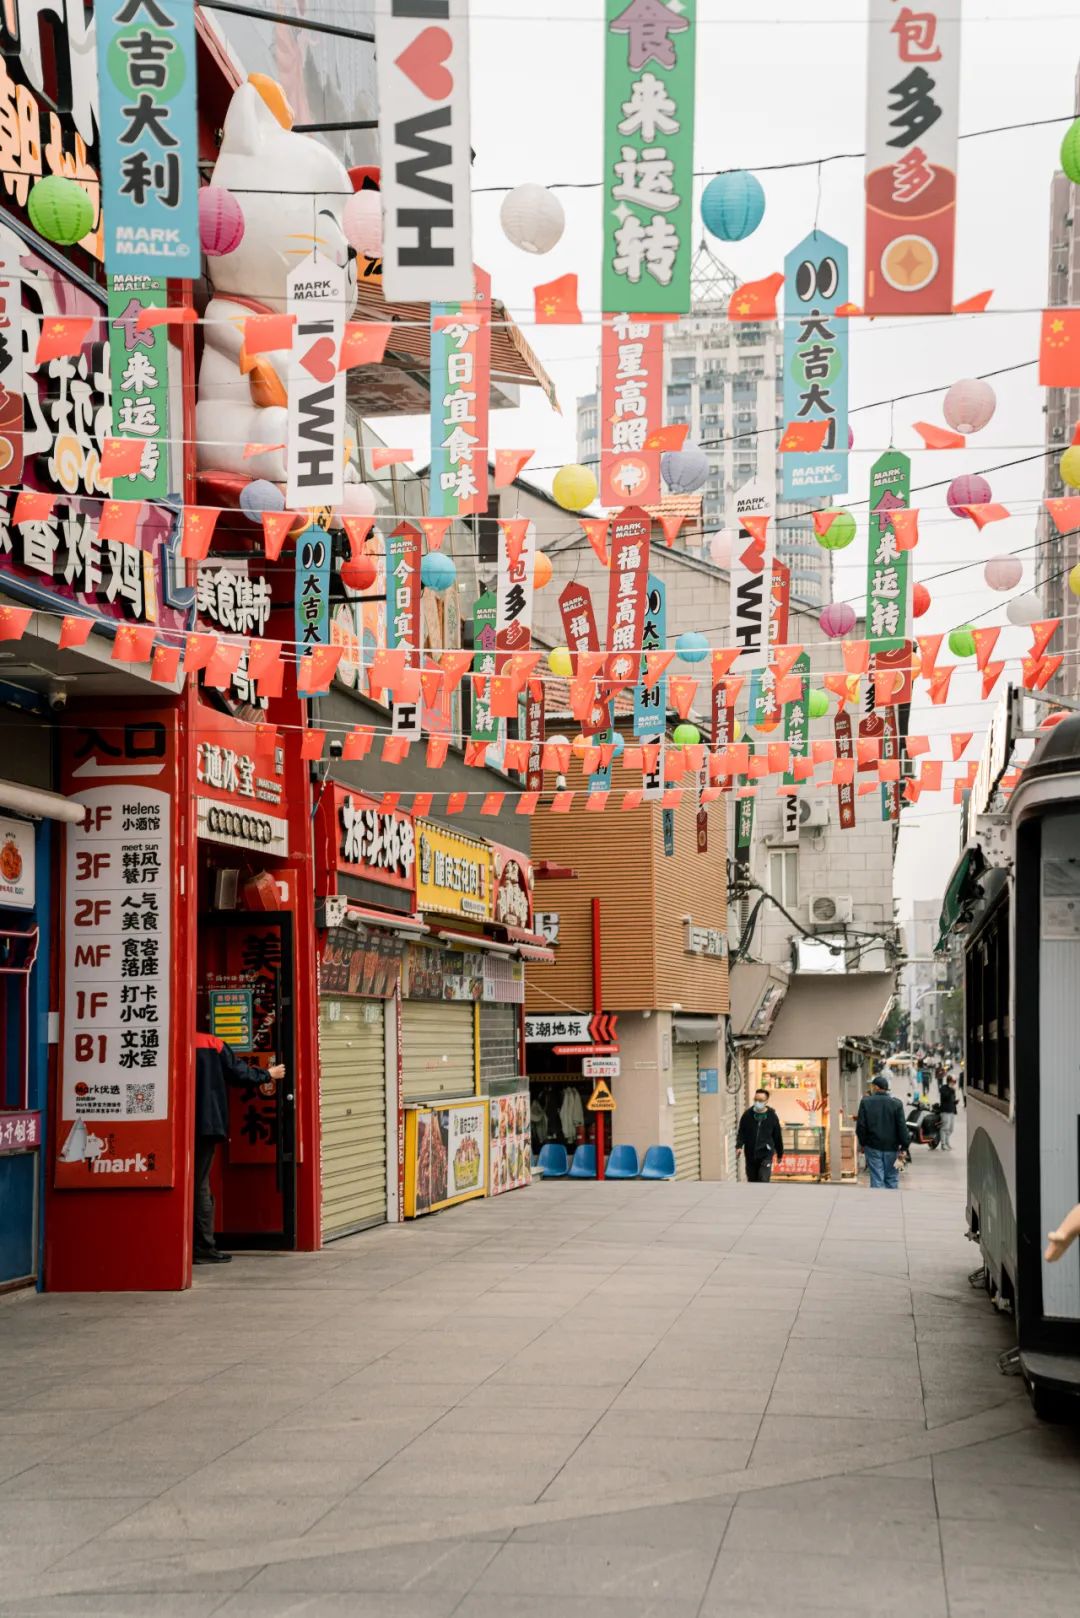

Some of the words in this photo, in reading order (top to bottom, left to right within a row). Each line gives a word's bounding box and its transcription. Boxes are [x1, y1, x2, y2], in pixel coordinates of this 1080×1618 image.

[885, 0, 943, 203] 包多多
[394, 104, 455, 267] WH
[115, 227, 181, 243] MARK
[293, 280, 332, 292] MARK
[297, 385, 336, 488] WH
[791, 464, 836, 477] MARK
[873, 468, 901, 481] MARK
[736, 496, 766, 507] MARK
[615, 522, 641, 533] MARK
[389, 540, 414, 549] MARK
[503, 536, 528, 646] 包多多
[562, 595, 584, 608] MARK
[612, 545, 642, 652] 福星高照
[196, 566, 273, 638] 美食集市
[301, 574, 323, 656] 大吉大
[736, 574, 764, 656] WH
[74, 722, 166, 759] 入口
[196, 741, 256, 798] 通冰室
[75, 805, 112, 833] 4F
[122, 802, 161, 815] Helens
[122, 817, 161, 831] 小酒馆
[75, 852, 111, 881] 3F
[122, 851, 162, 868] 韩风
[122, 867, 160, 884] 餐厅
[120, 891, 159, 911] 人气
[74, 898, 111, 927] 2F
[121, 911, 159, 931] 美食
[74, 944, 111, 968] MF
[121, 937, 159, 958] 食客
[121, 956, 159, 978] 落座
[120, 984, 158, 1003] 打卡
[76, 990, 108, 1020] 1F
[119, 1003, 159, 1023] 小吃
[74, 1033, 108, 1064] B1
[120, 1028, 160, 1049] 文通
[118, 1048, 158, 1069] 冰室
[93, 1152, 148, 1173] mark
